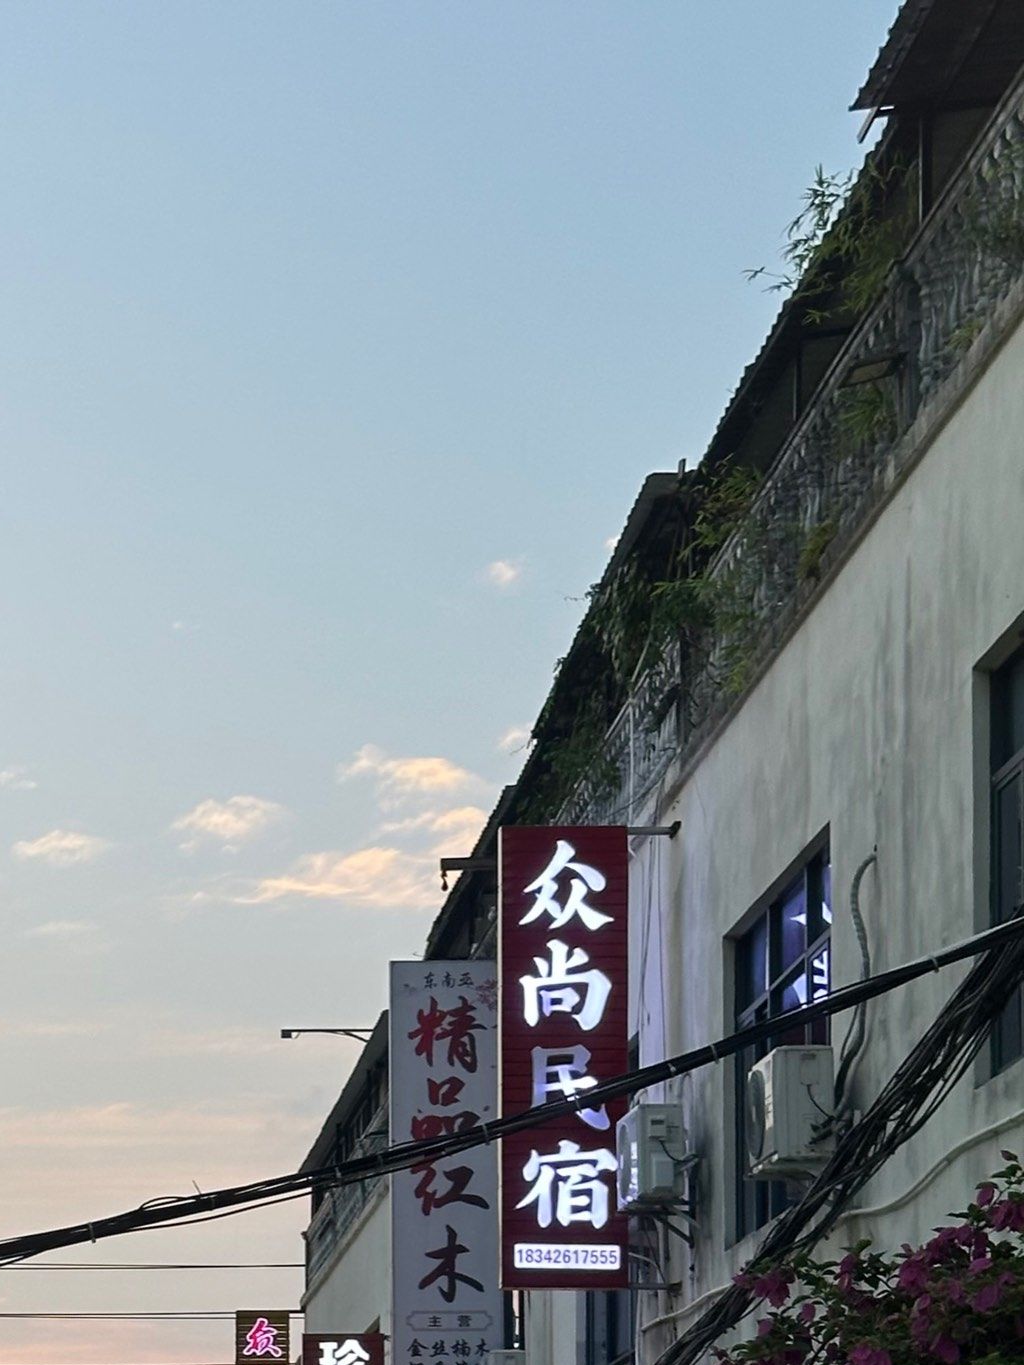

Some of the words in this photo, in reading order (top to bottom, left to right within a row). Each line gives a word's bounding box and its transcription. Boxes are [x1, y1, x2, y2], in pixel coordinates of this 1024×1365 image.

[423, 971, 474, 990] 东南亚
[515, 840, 619, 1229] 众尚民宿
[408, 996, 490, 1302] 精品红木
[516, 1248, 618, 1265] 18342617555
[428, 1315, 472, 1327] 主营
